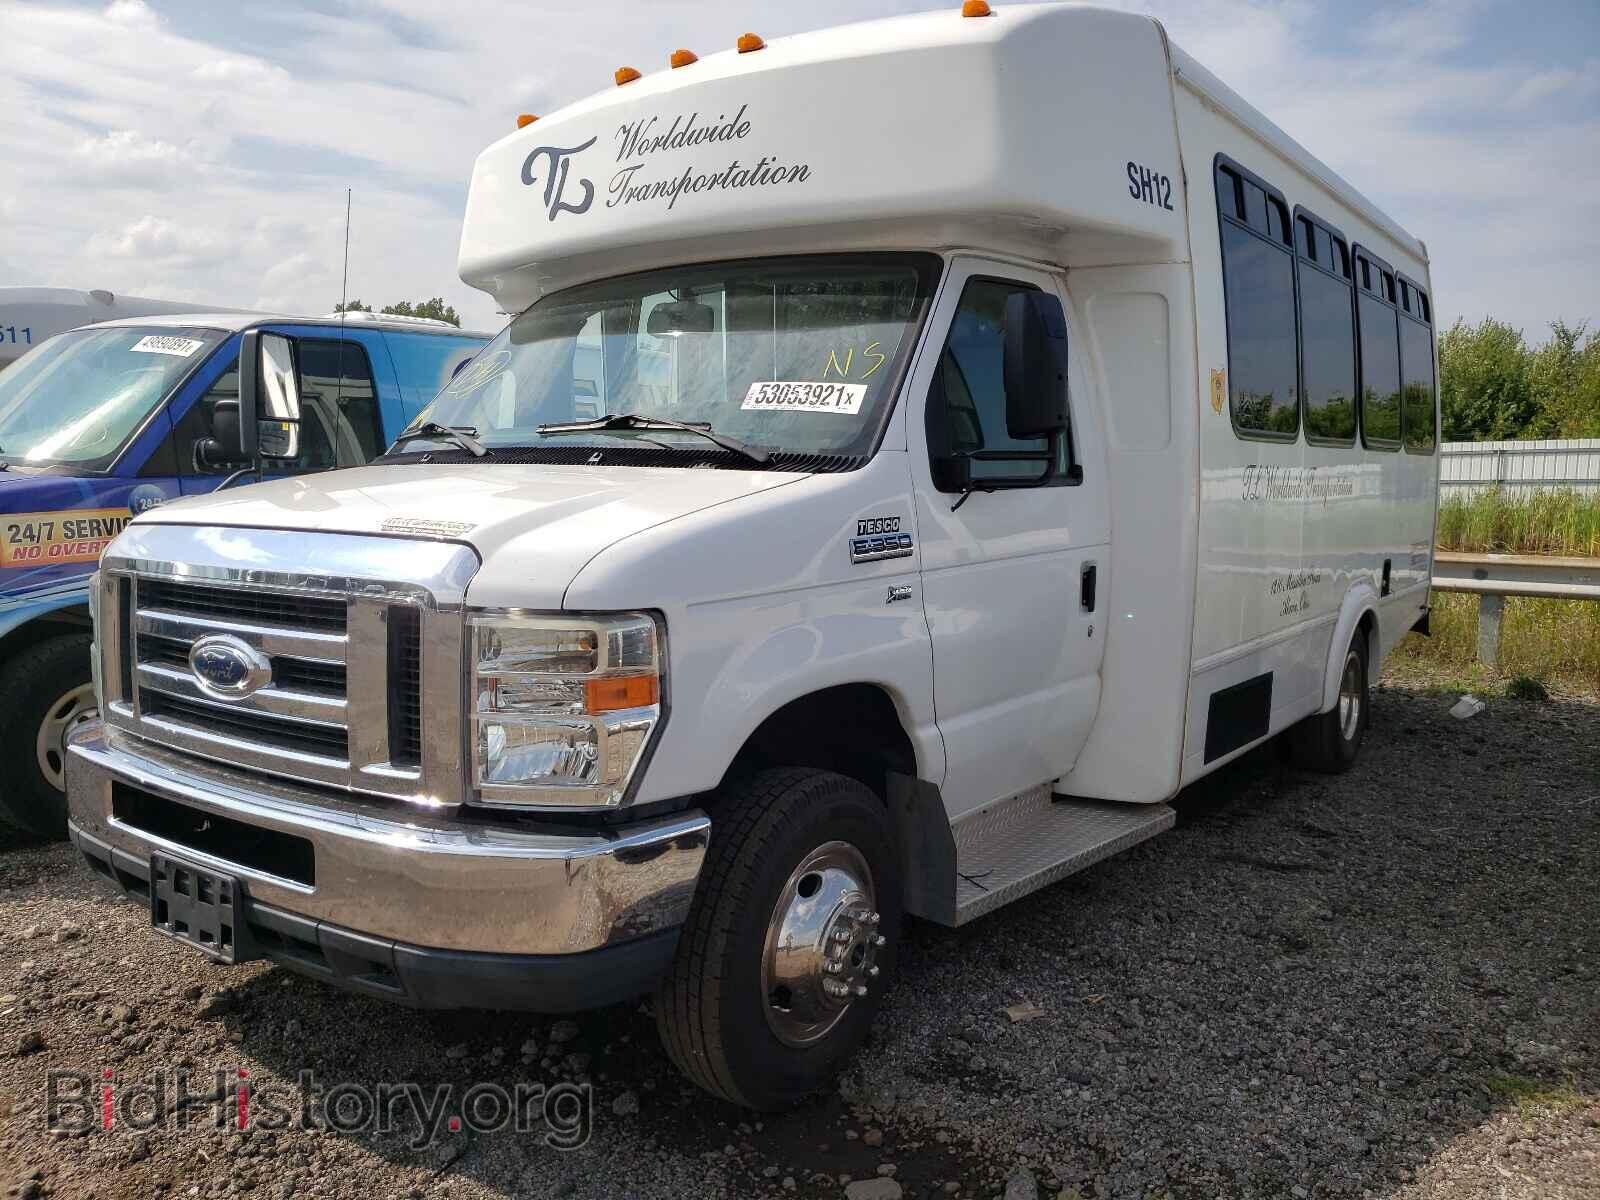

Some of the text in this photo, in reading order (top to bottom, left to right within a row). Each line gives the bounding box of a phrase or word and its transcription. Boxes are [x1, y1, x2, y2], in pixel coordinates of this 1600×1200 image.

[614, 103, 752, 162] Worldwide
[520, 135, 598, 222] TL
[605, 156, 812, 210] Transportation
[1127, 161, 1174, 211] SH12
[7, 522, 54, 544] 24/7
[857, 517, 901, 536] TESCO
[12, 546, 41, 560] NO
